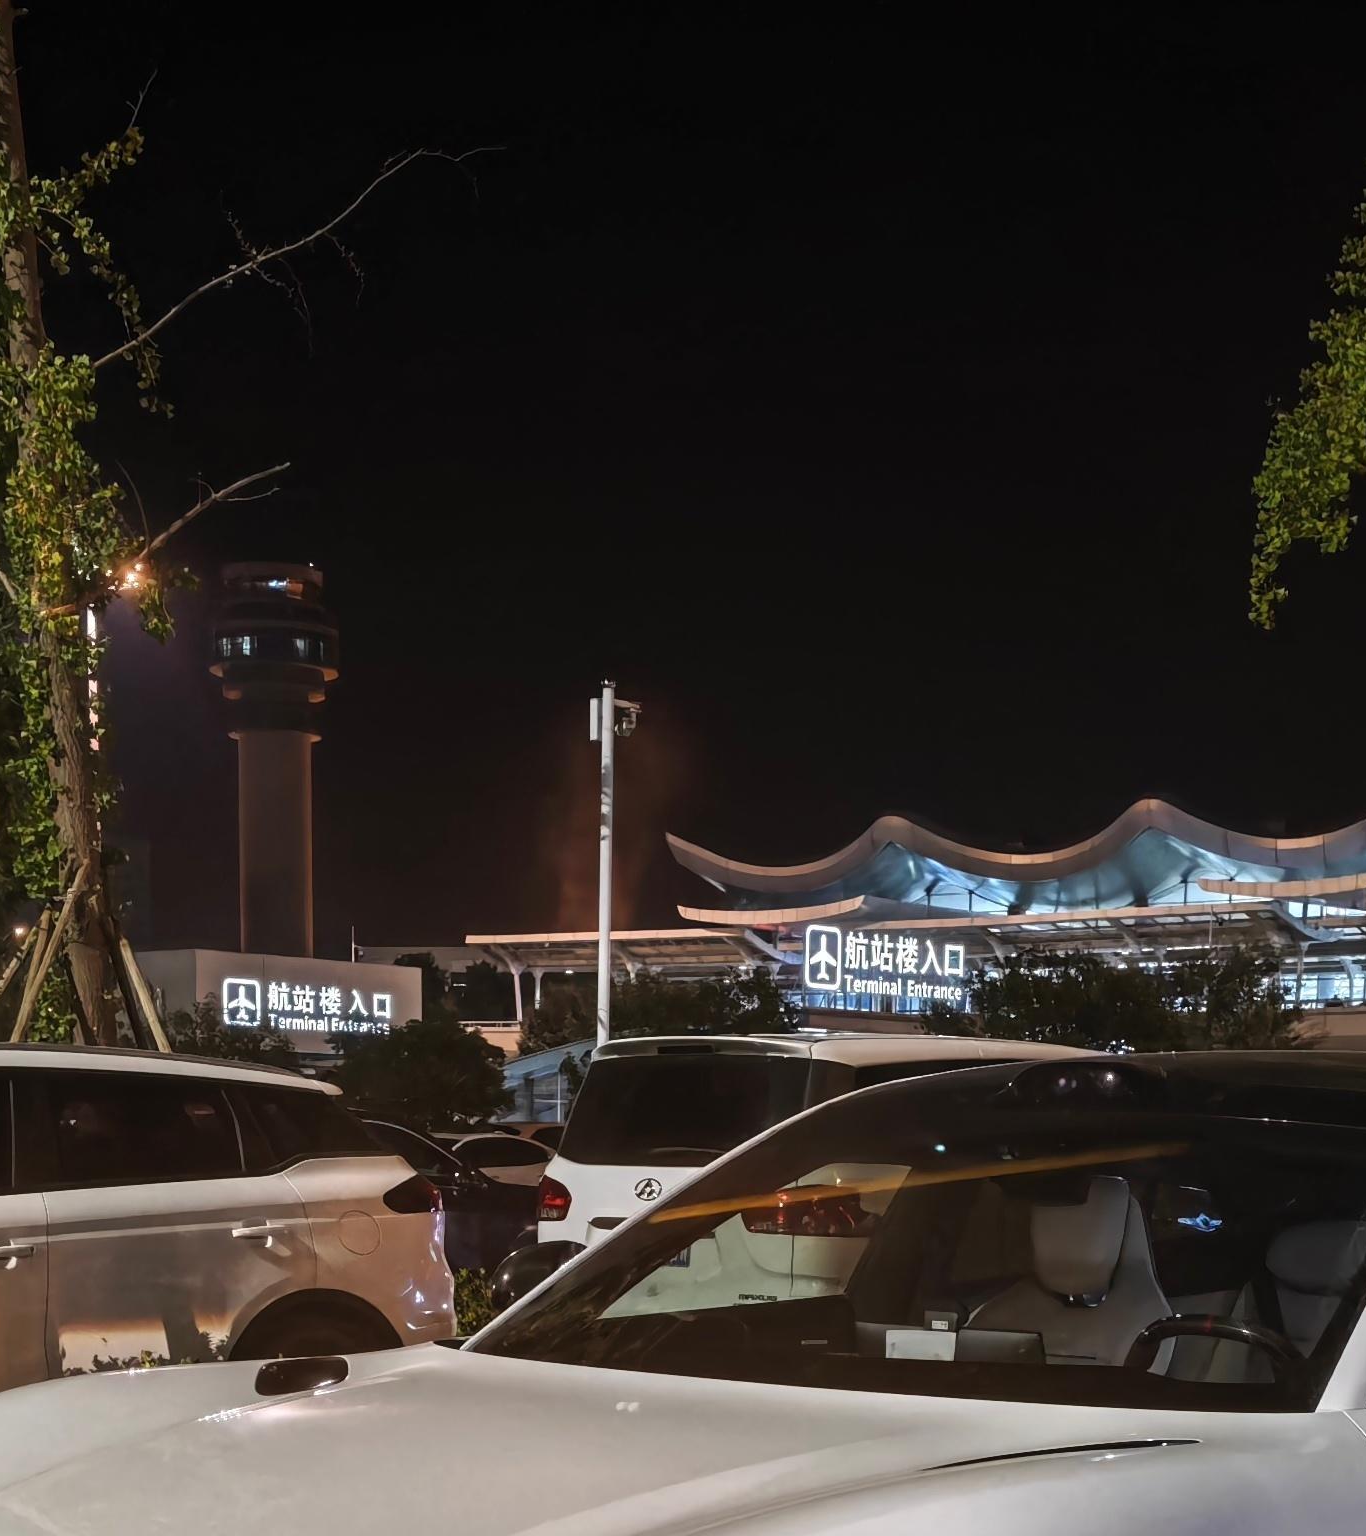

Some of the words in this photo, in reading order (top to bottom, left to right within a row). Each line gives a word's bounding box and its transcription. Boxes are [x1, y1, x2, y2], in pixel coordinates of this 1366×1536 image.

[844, 931, 965, 978] 航站楼入口
[267, 982, 392, 1019] 航站楼入口
[844, 975, 902, 996] Terminal
[907, 979, 963, 1001] Entrance
[268, 1013, 328, 1032] Terminal
